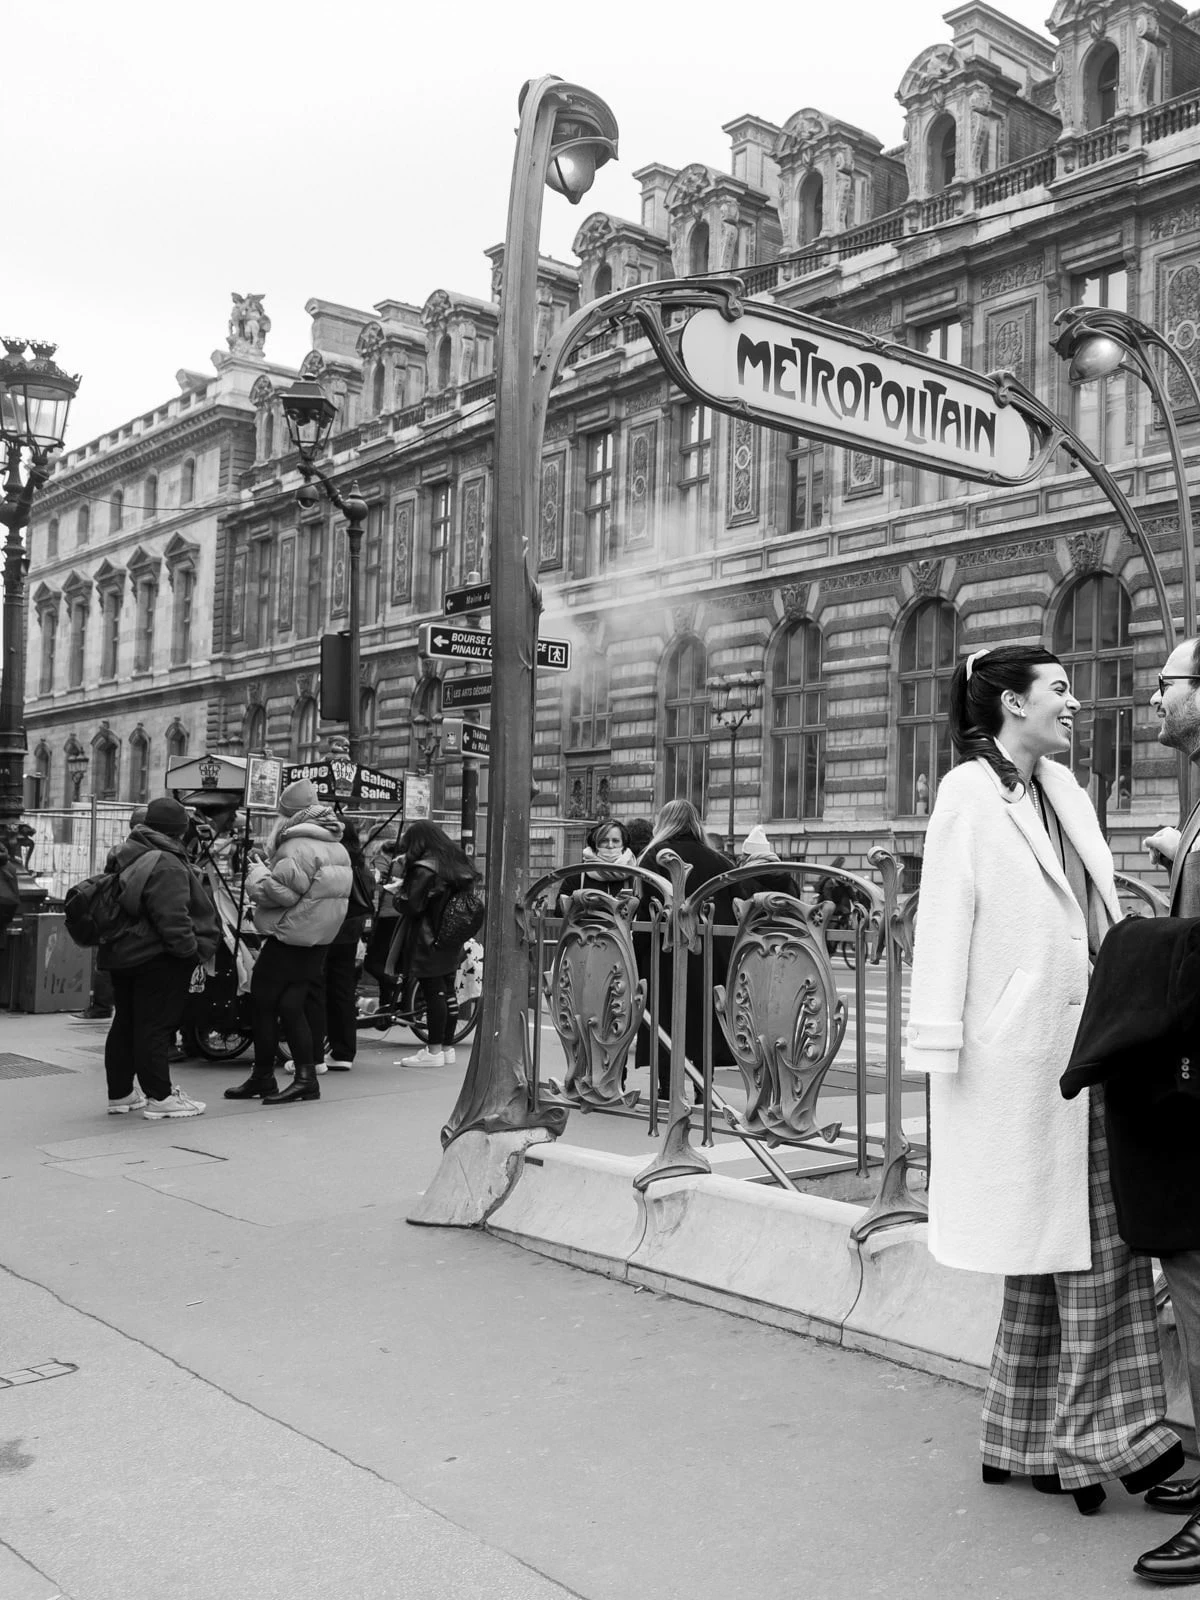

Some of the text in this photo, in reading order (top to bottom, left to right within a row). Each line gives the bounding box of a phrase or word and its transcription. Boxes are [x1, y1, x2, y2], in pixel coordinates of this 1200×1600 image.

[737, 332, 997, 457] METROPOLITAIN
[451, 632, 486, 645] BOURSE
[451, 644, 488, 656] PINAULT
[360, 785, 391, 800] Salée
